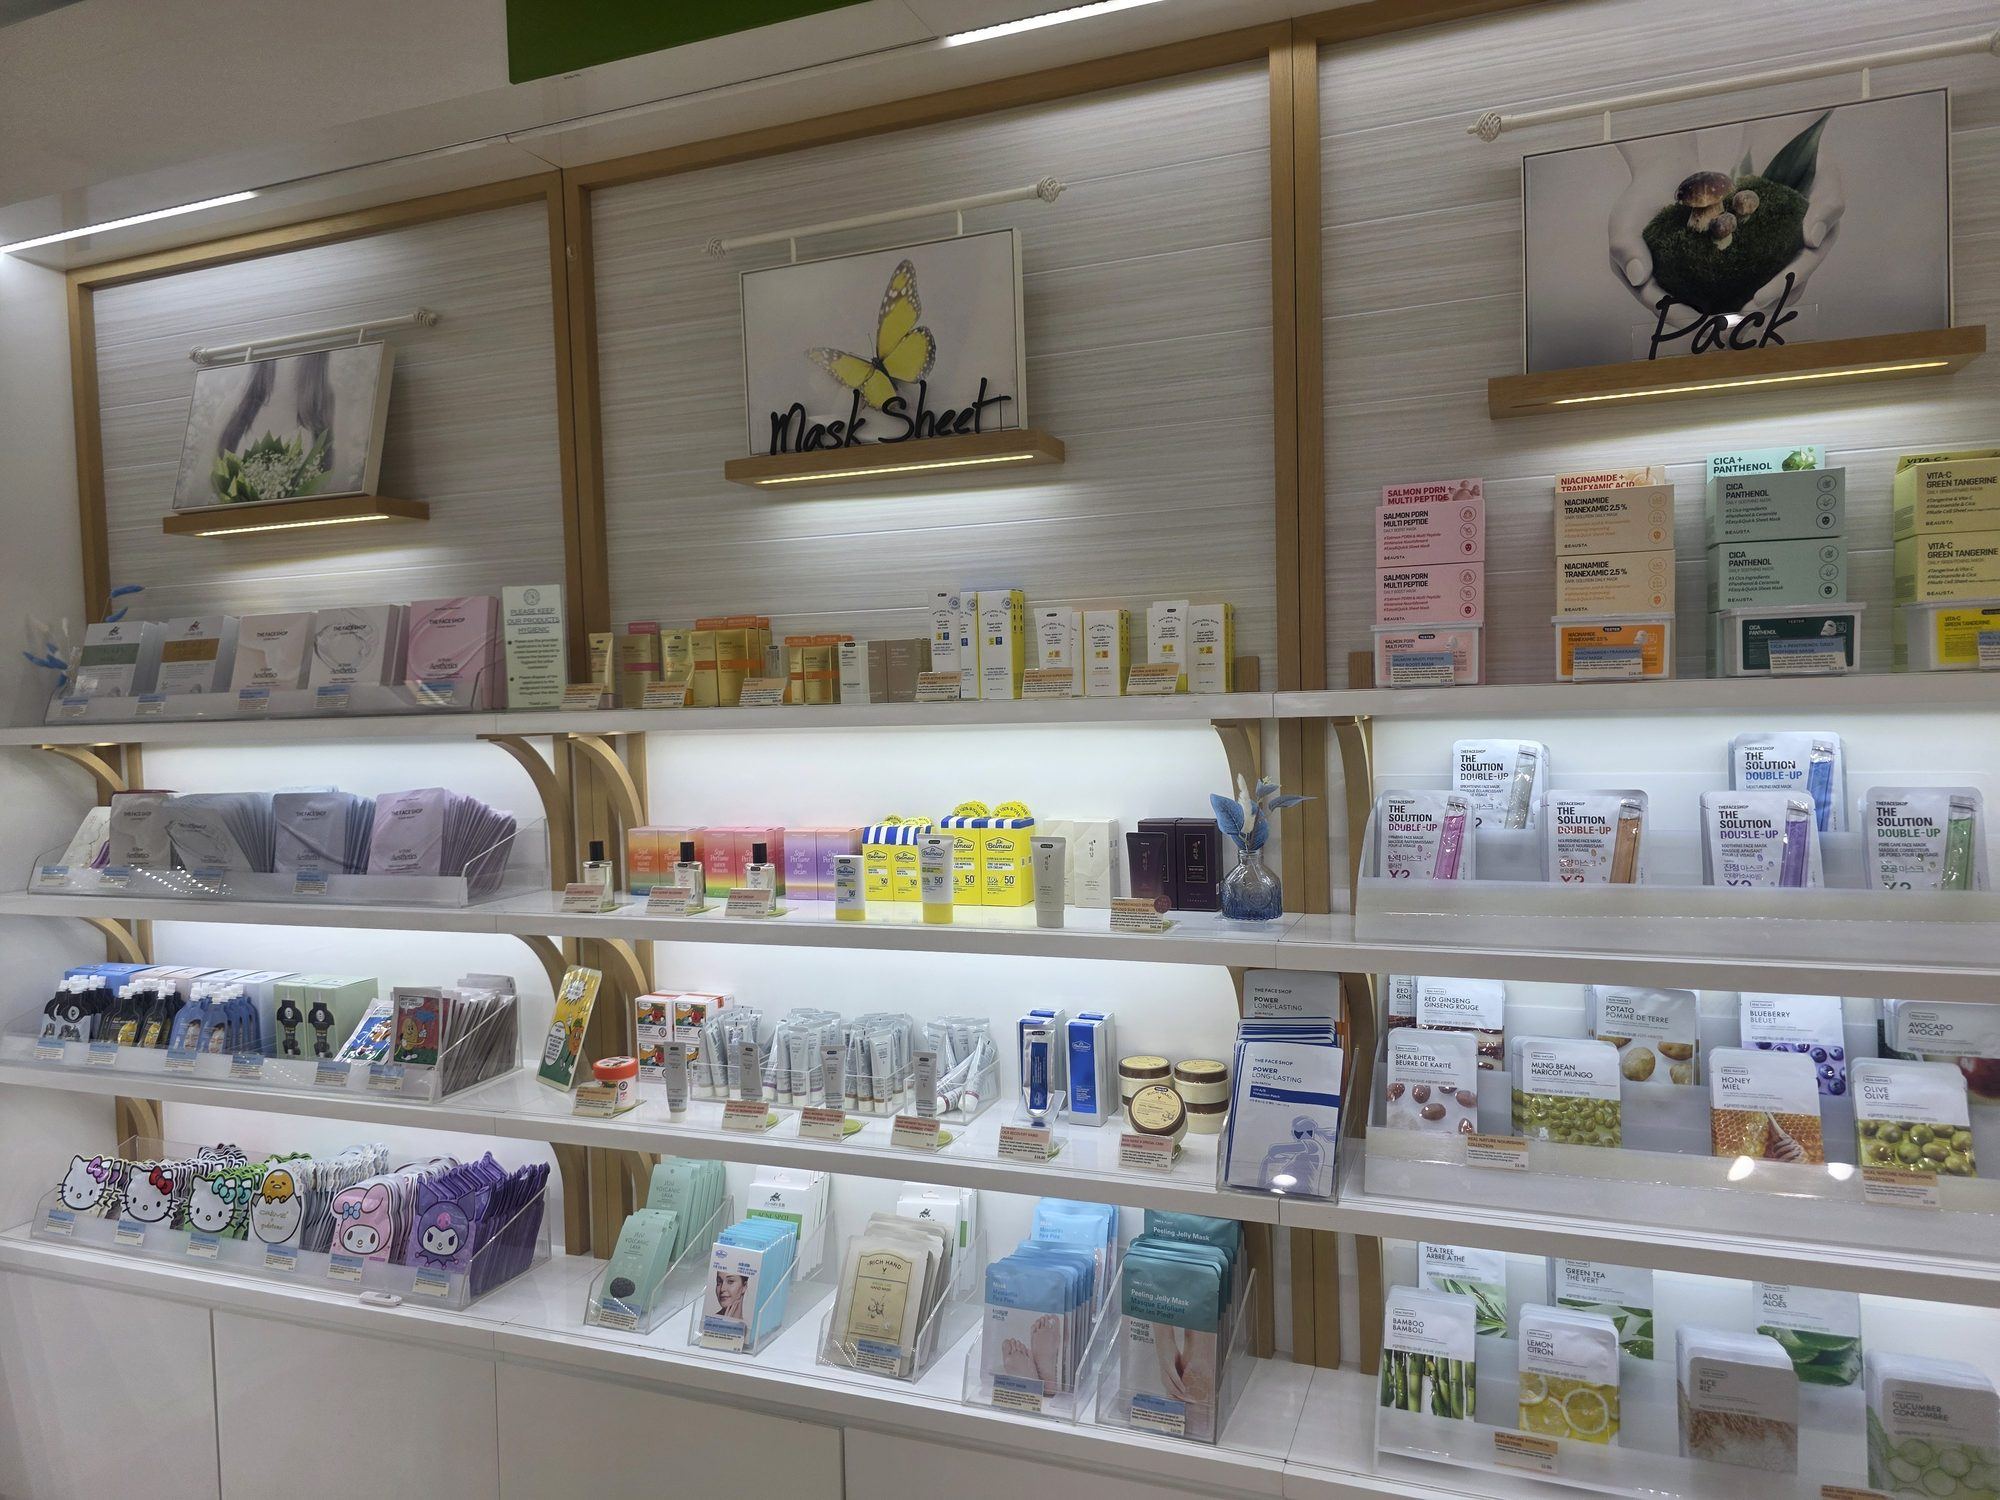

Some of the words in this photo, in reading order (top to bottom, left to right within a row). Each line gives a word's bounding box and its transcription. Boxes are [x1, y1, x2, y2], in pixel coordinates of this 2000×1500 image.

[1649, 273, 1798, 359] Pack
[770, 389, 866, 455] Mask
[878, 378, 1011, 443] Sheet
[1714, 457, 1735, 465] CICA
[1714, 463, 1772, 474] PANTHENOL
[1561, 474, 1617, 485] NIACINAMIDE
[1927, 471, 1952, 479] VITA-C
[1927, 480, 1952, 488] GREEN
[1954, 476, 1997, 486] TANGERINE
[1388, 488, 1422, 497] SALMON
[1424, 486, 1446, 495] PDRN
[1726, 490, 1769, 499] PANTHENOL
[1388, 496, 1413, 505] MULTI
[1414, 493, 1448, 504] PEPTIDE
[1564, 497, 1609, 506] NIACINAMIDE
[1565, 505, 1608, 514] TRANEXAMIC
[1404, 518, 1428, 526] PEPTIDE
[1928, 542, 1953, 550] VITA-C
[1729, 551, 1746, 559] CICA
[1955, 548, 1998, 557] TANGERINE
[1564, 561, 1609, 570] NIACINAMIDE
[1729, 558, 1771, 566] PANTHENOL
[1565, 570, 1609, 578] TRANEXAMIC
[1746, 752, 1764, 760] THE
[1460, 763, 1503, 771] SOLUTION
[1746, 761, 1795, 770] SOLUTION
[1746, 771, 1802, 780] DOUBLE-UP
[1389, 805, 1405, 813] THE
[1557, 807, 1575, 815] THE
[1876, 807, 1896, 816] THE
[1389, 814, 1432, 822] SOLUTION
[1719, 811, 1738, 819] THE
[1558, 816, 1605, 824] SOLUTION
[1720, 820, 1771, 828] SOLUTION
[1877, 817, 1932, 826] SOLUTION
[1558, 826, 1611, 834] DOUBLE-UP
[1721, 830, 1778, 839] DOUBLE-UP
[1878, 829, 1940, 837] DOUBLE-UP
[1254, 1003, 1302, 1011] LONG-LASTING
[1606, 1005, 1634, 1013] POTATO
[1606, 1012, 1633, 1020] POMME
[1908, 1022, 1953, 1031] AVOCADO
[1431, 1061, 1451, 1069] KARITÉ
[1252, 1073, 1302, 1083] LONG-LASTING
[1153, 1227, 1175, 1237] Peeling
[1176, 1231, 1192, 1240] Jelly
[1193, 1233, 1210, 1241] Mask
[1454, 1254, 1465, 1262] THÉ
[885, 1260, 902, 1270] HAND
[1566, 1268, 1590, 1276] GREEN
[1593, 1271, 1605, 1279] TEA
[1131, 1288, 1154, 1300] Peeling
[1154, 1294, 1170, 1304] Jelly
[1171, 1297, 1189, 1306] Mask
[1763, 1292, 1784, 1301] ALOE
[1157, 1303, 1186, 1314] Exfoliant
[1393, 1318, 1424, 1327] BAMBOO
[1393, 1325, 1423, 1334] BAMBOU
[1527, 1340, 1553, 1349] LEMON
[1527, 1346, 1554, 1356] CITRON
[1700, 1378, 1717, 1386] RICE
[1893, 1401, 1941, 1412] CUCUMBER
[1893, 1409, 1949, 1421] CONCOMBRE
